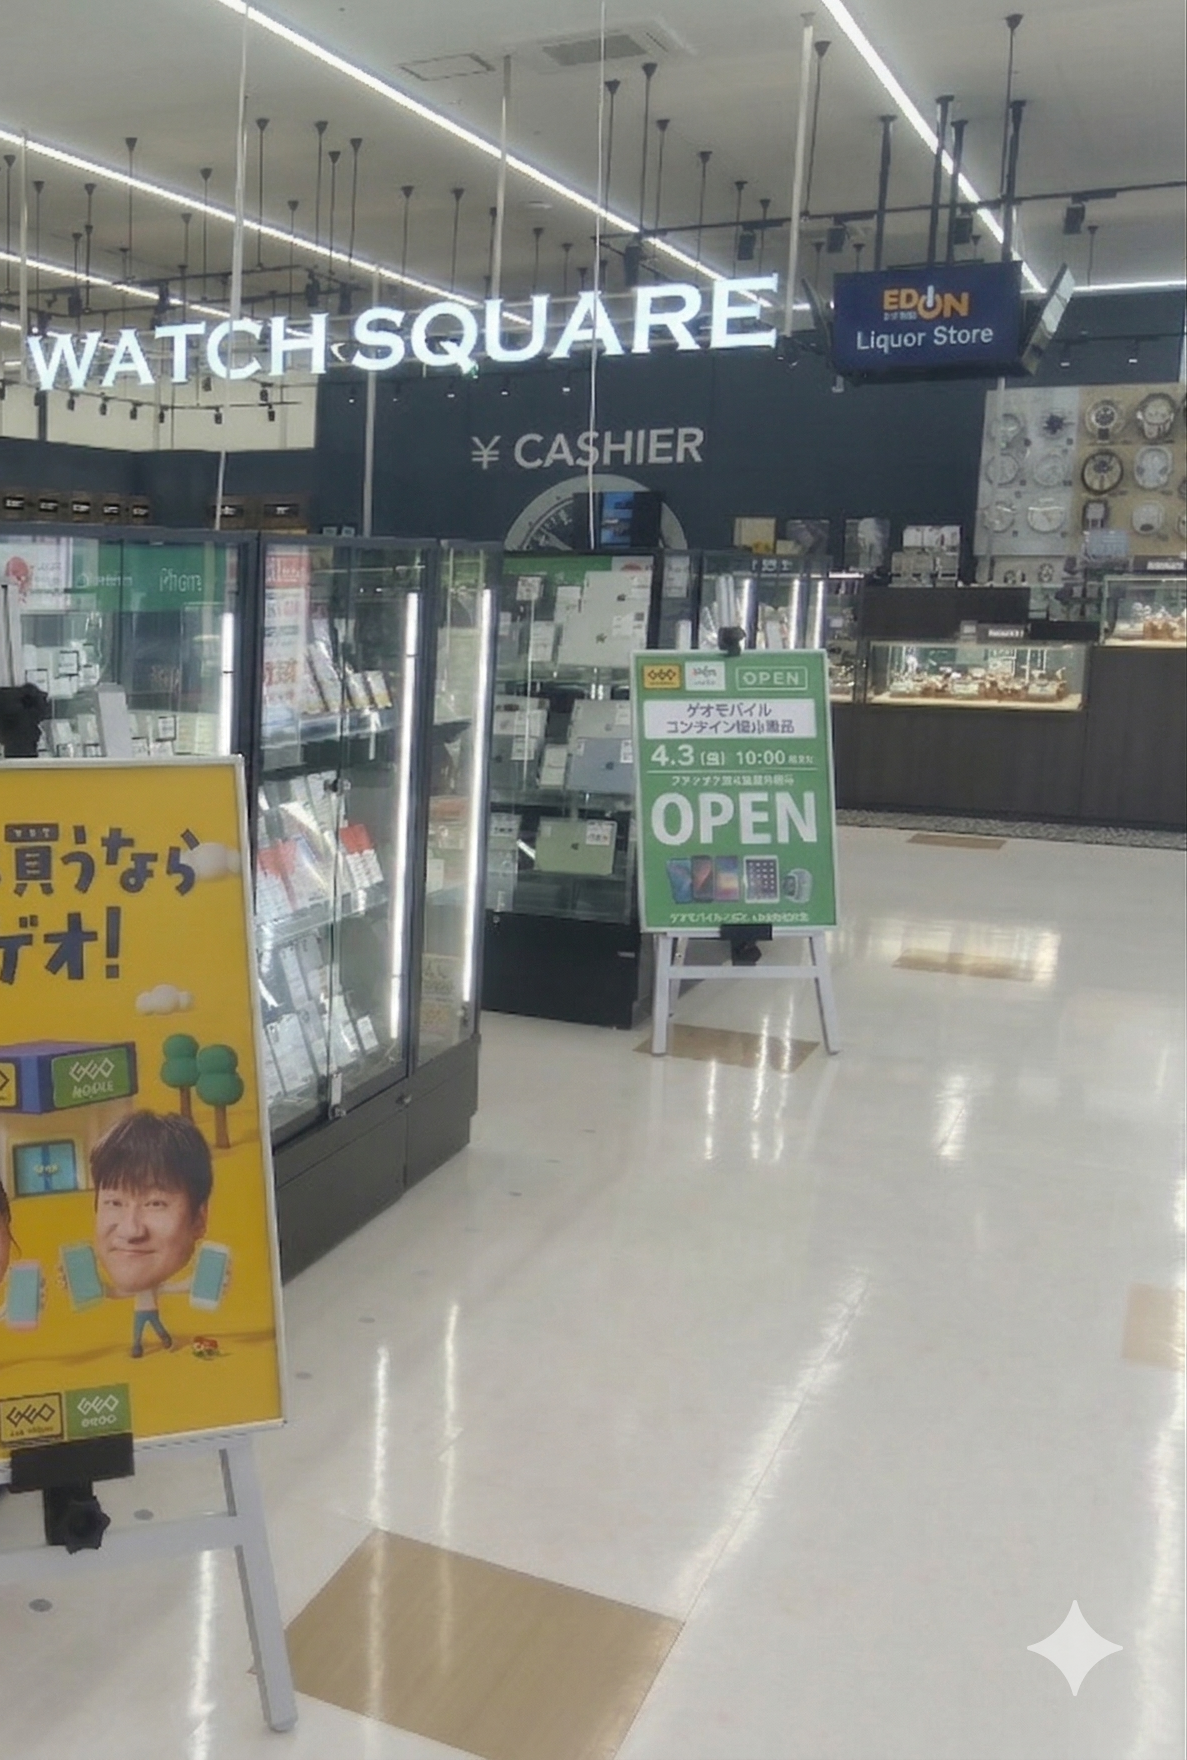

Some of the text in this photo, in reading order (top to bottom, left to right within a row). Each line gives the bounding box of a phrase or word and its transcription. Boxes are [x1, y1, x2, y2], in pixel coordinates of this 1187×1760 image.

[27, 273, 778, 390] WATCH SQUARE
[856, 325, 994, 354] Liquor Store
[514, 427, 704, 469] CASHIER
[743, 671, 799, 686] OPEN
[686, 702, 772, 719] ゲオモバイル
[651, 744, 694, 767] 4.3
[736, 750, 786, 766] 10:00
[651, 791, 818, 846] OPEN
[69, 1057, 115, 1083] GEO
[6, 1403, 55, 1428] GEO
[77, 1394, 119, 1416] GEO
